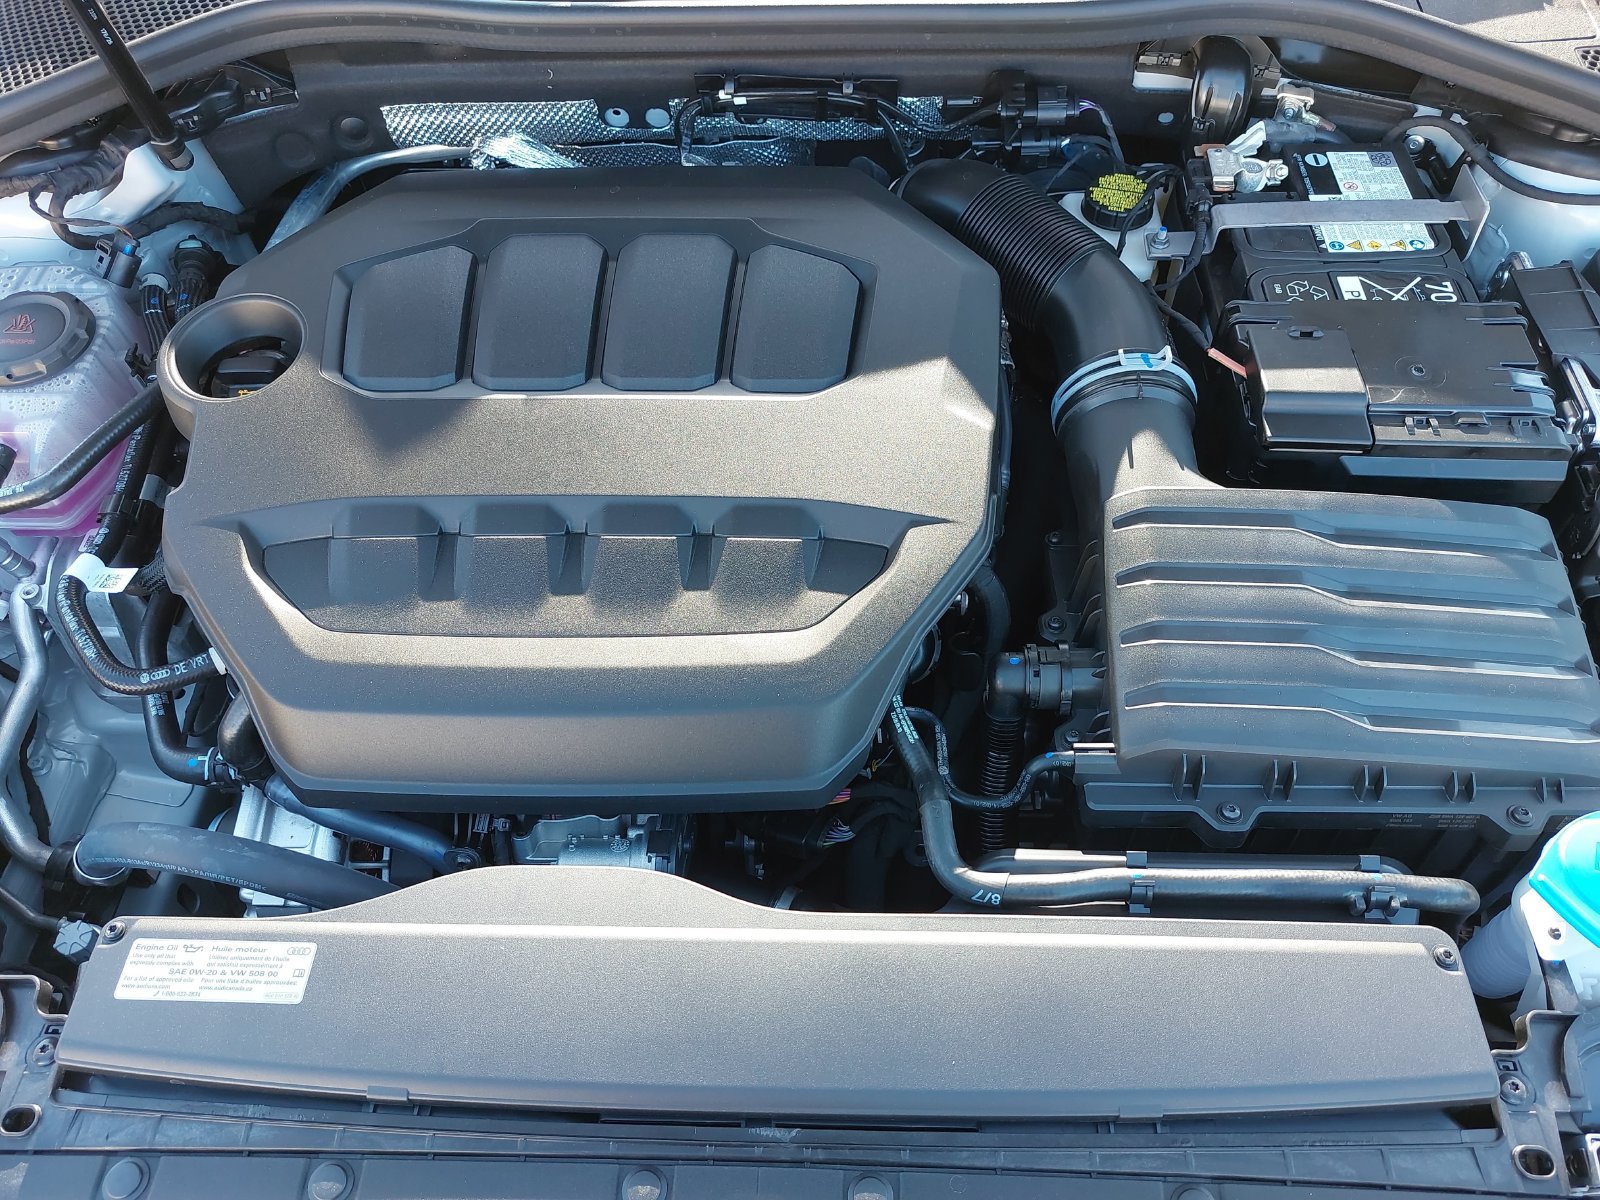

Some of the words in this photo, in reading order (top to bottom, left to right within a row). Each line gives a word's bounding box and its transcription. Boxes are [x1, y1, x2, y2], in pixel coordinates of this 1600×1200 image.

[1425, 281, 1458, 302] 70
[174, 662, 188, 676] DE
[190, 655, 209, 669] VRT
[972, 889, 1002, 906] 8/7
[136, 943, 164, 951] Engine
[189, 968, 217, 976] 0W-20
